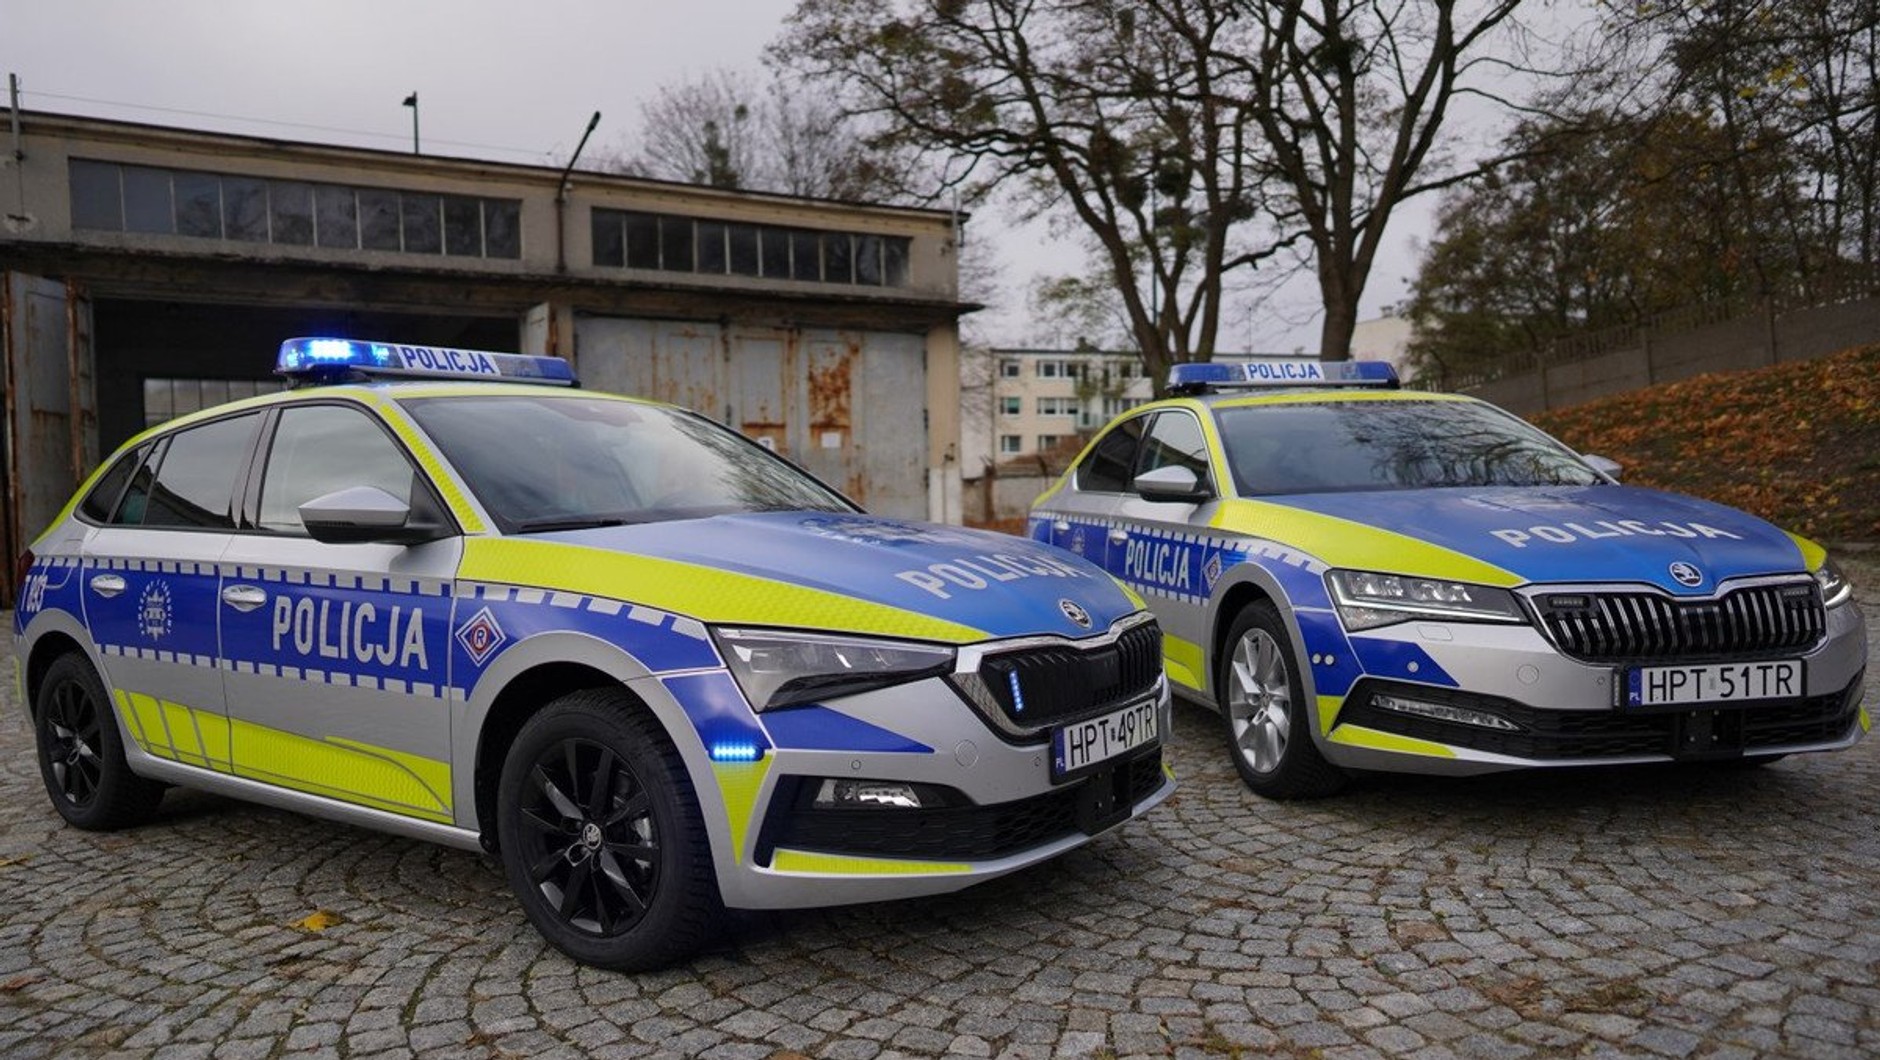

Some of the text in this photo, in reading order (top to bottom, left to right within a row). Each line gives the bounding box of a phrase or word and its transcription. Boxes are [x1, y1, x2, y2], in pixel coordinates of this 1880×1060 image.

[403, 346, 495, 374] POLICJA
[1249, 363, 1320, 379] POLICJA
[1489, 519, 1744, 548] POLICJA
[895, 552, 1092, 600] POLICJA
[1125, 537, 1190, 590] POLICJA
[272, 595, 428, 670] POLICJA
[1629, 692, 1640, 702] PL
[1649, 664, 1793, 702] HPT 51TR
[1069, 704, 1154, 767] HPT 49TR
[1056, 757, 1064, 769] PL
